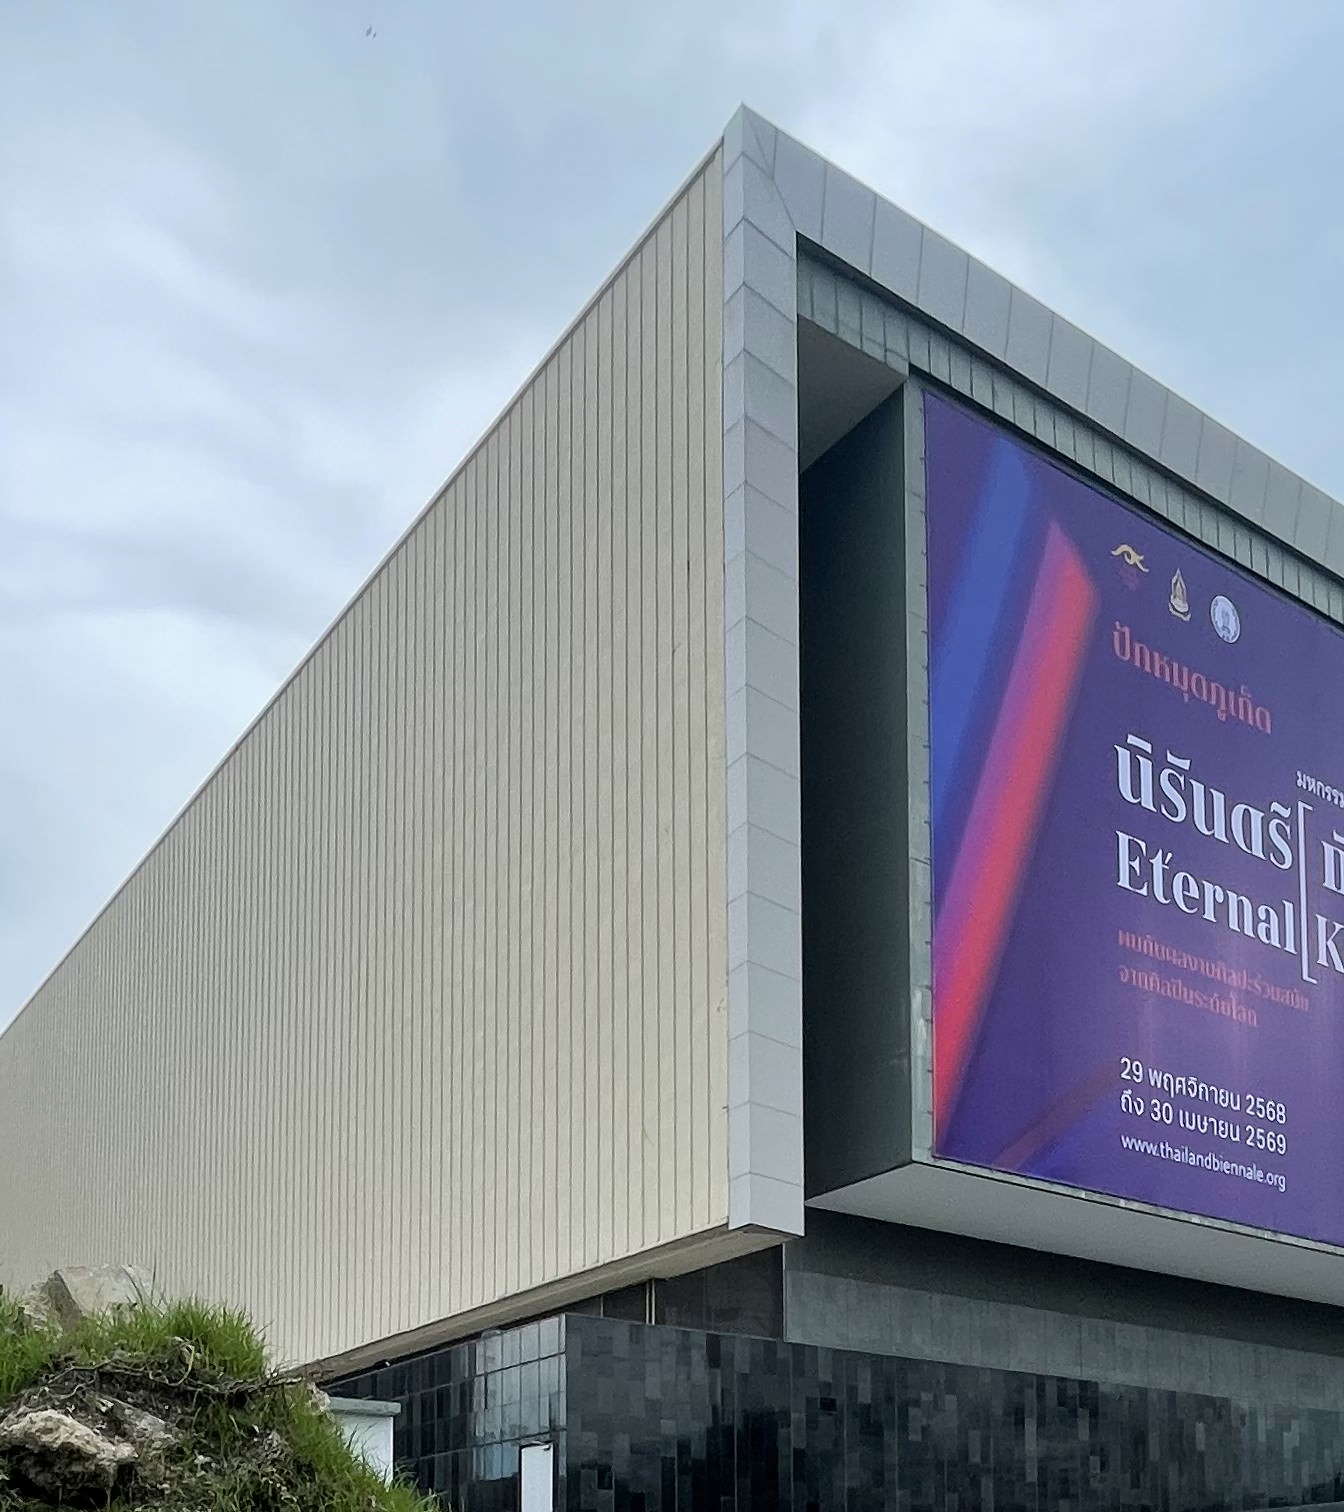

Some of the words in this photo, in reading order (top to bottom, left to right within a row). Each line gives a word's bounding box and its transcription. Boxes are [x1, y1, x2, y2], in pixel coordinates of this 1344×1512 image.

[1112, 620, 1273, 736] ปักหมุดภูเก็ต
[1115, 830, 1298, 955] Eternal
[1120, 1057, 1143, 1083] 29
[1148, 1067, 1241, 1111] พฤศจิกายน
[1245, 1094, 1287, 1125] 2568
[1120, 1088, 1145, 1116] ถึง
[1150, 1099, 1174, 1125] 30
[1178, 1108, 1240, 1142] เมษายน
[1245, 1124, 1287, 1156] 2569
[1120, 1134, 1286, 1193] www.thailandbiennale.org
